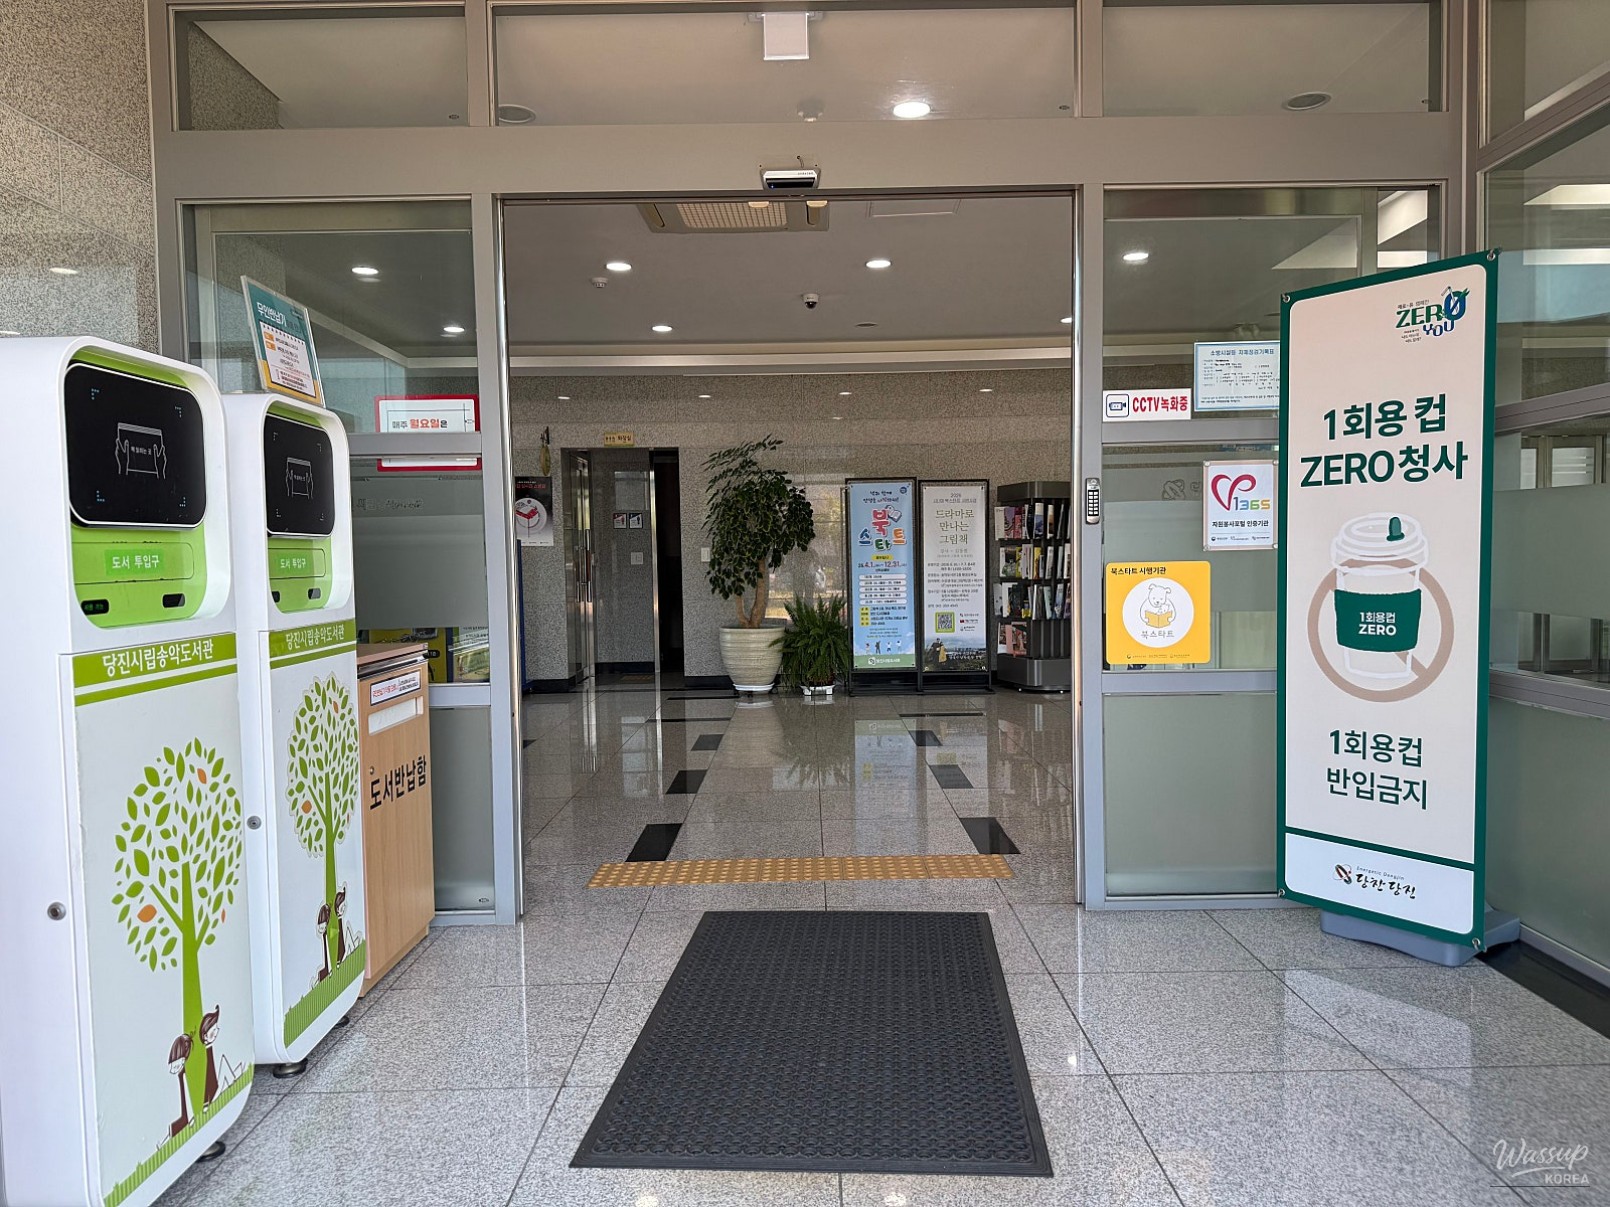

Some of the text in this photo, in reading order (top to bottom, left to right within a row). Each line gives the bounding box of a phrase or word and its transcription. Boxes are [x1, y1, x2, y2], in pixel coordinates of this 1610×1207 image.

[1396, 290, 1467, 328] ZERO
[1422, 320, 1455, 336] YOU
[1132, 396, 1188, 413] CCTV녹화중
[392, 418, 448, 429] 매주 월요일은
[1323, 393, 1446, 440] 1회용 컵
[1233, 496, 1271, 511] 1365
[935, 508, 974, 519] 드라마로
[939, 520, 969, 532] 만나는
[1211, 519, 1269, 528] 자원봉사포털 인증기관
[939, 533, 968, 545] 그림책
[112, 554, 160, 570] 도서 투입구
[280, 557, 306, 570] 도서 투입구
[1111, 566, 1167, 576] 북스타트 시행기관
[1359, 611, 1396, 623] 1회용컵
[286, 624, 345, 651] 당진시립송악도서관
[1140, 630, 1175, 640] 북스타트
[1358, 624, 1397, 636] ZERO
[102, 639, 213, 677] 당진시립송악도서관
[1329, 729, 1422, 768] 1회용컵
[370, 754, 427, 810] 도서반납함
[1326, 767, 1427, 810] 반입금지
[1355, 873, 1416, 900] 당찬 당진
